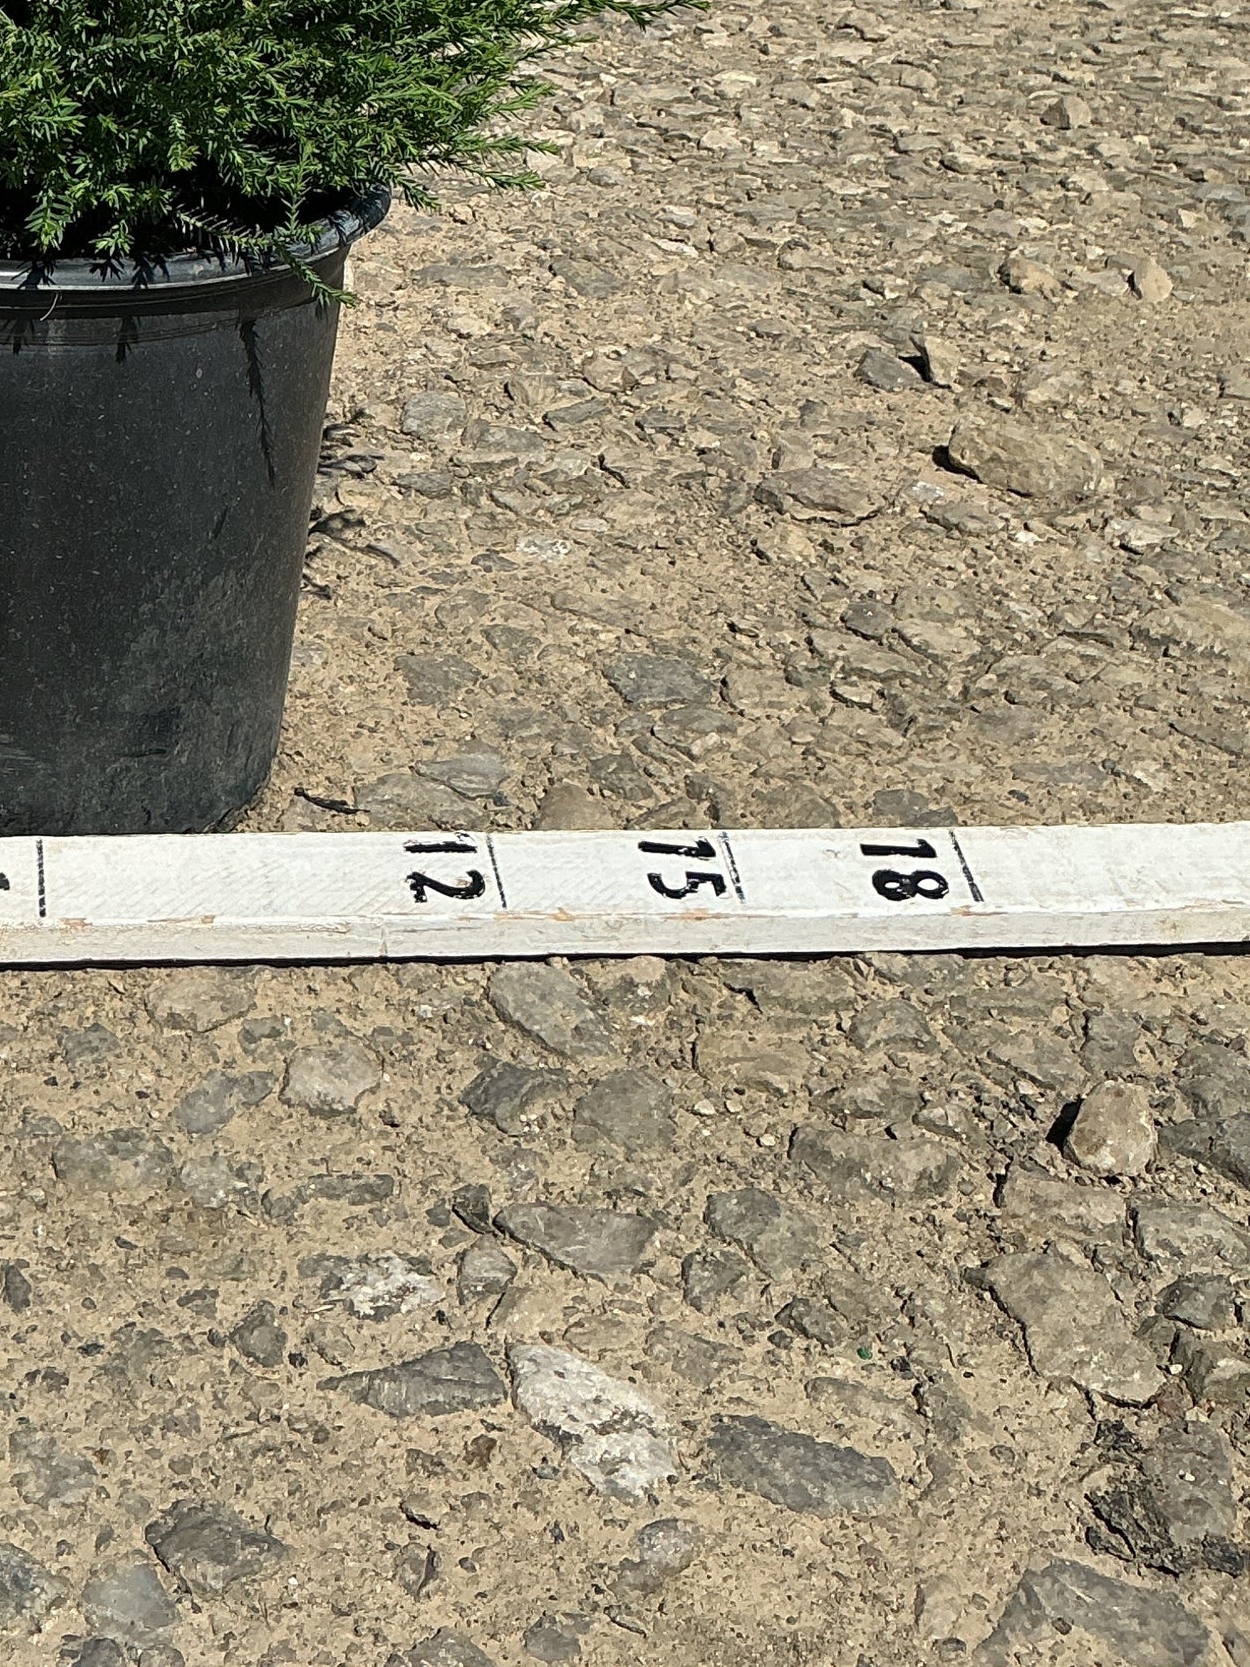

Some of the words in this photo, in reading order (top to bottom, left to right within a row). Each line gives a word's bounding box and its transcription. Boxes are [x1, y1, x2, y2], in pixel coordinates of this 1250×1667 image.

[404, 832, 487, 903] 12
[638, 837, 728, 900] 15
[859, 838, 950, 902] 18
